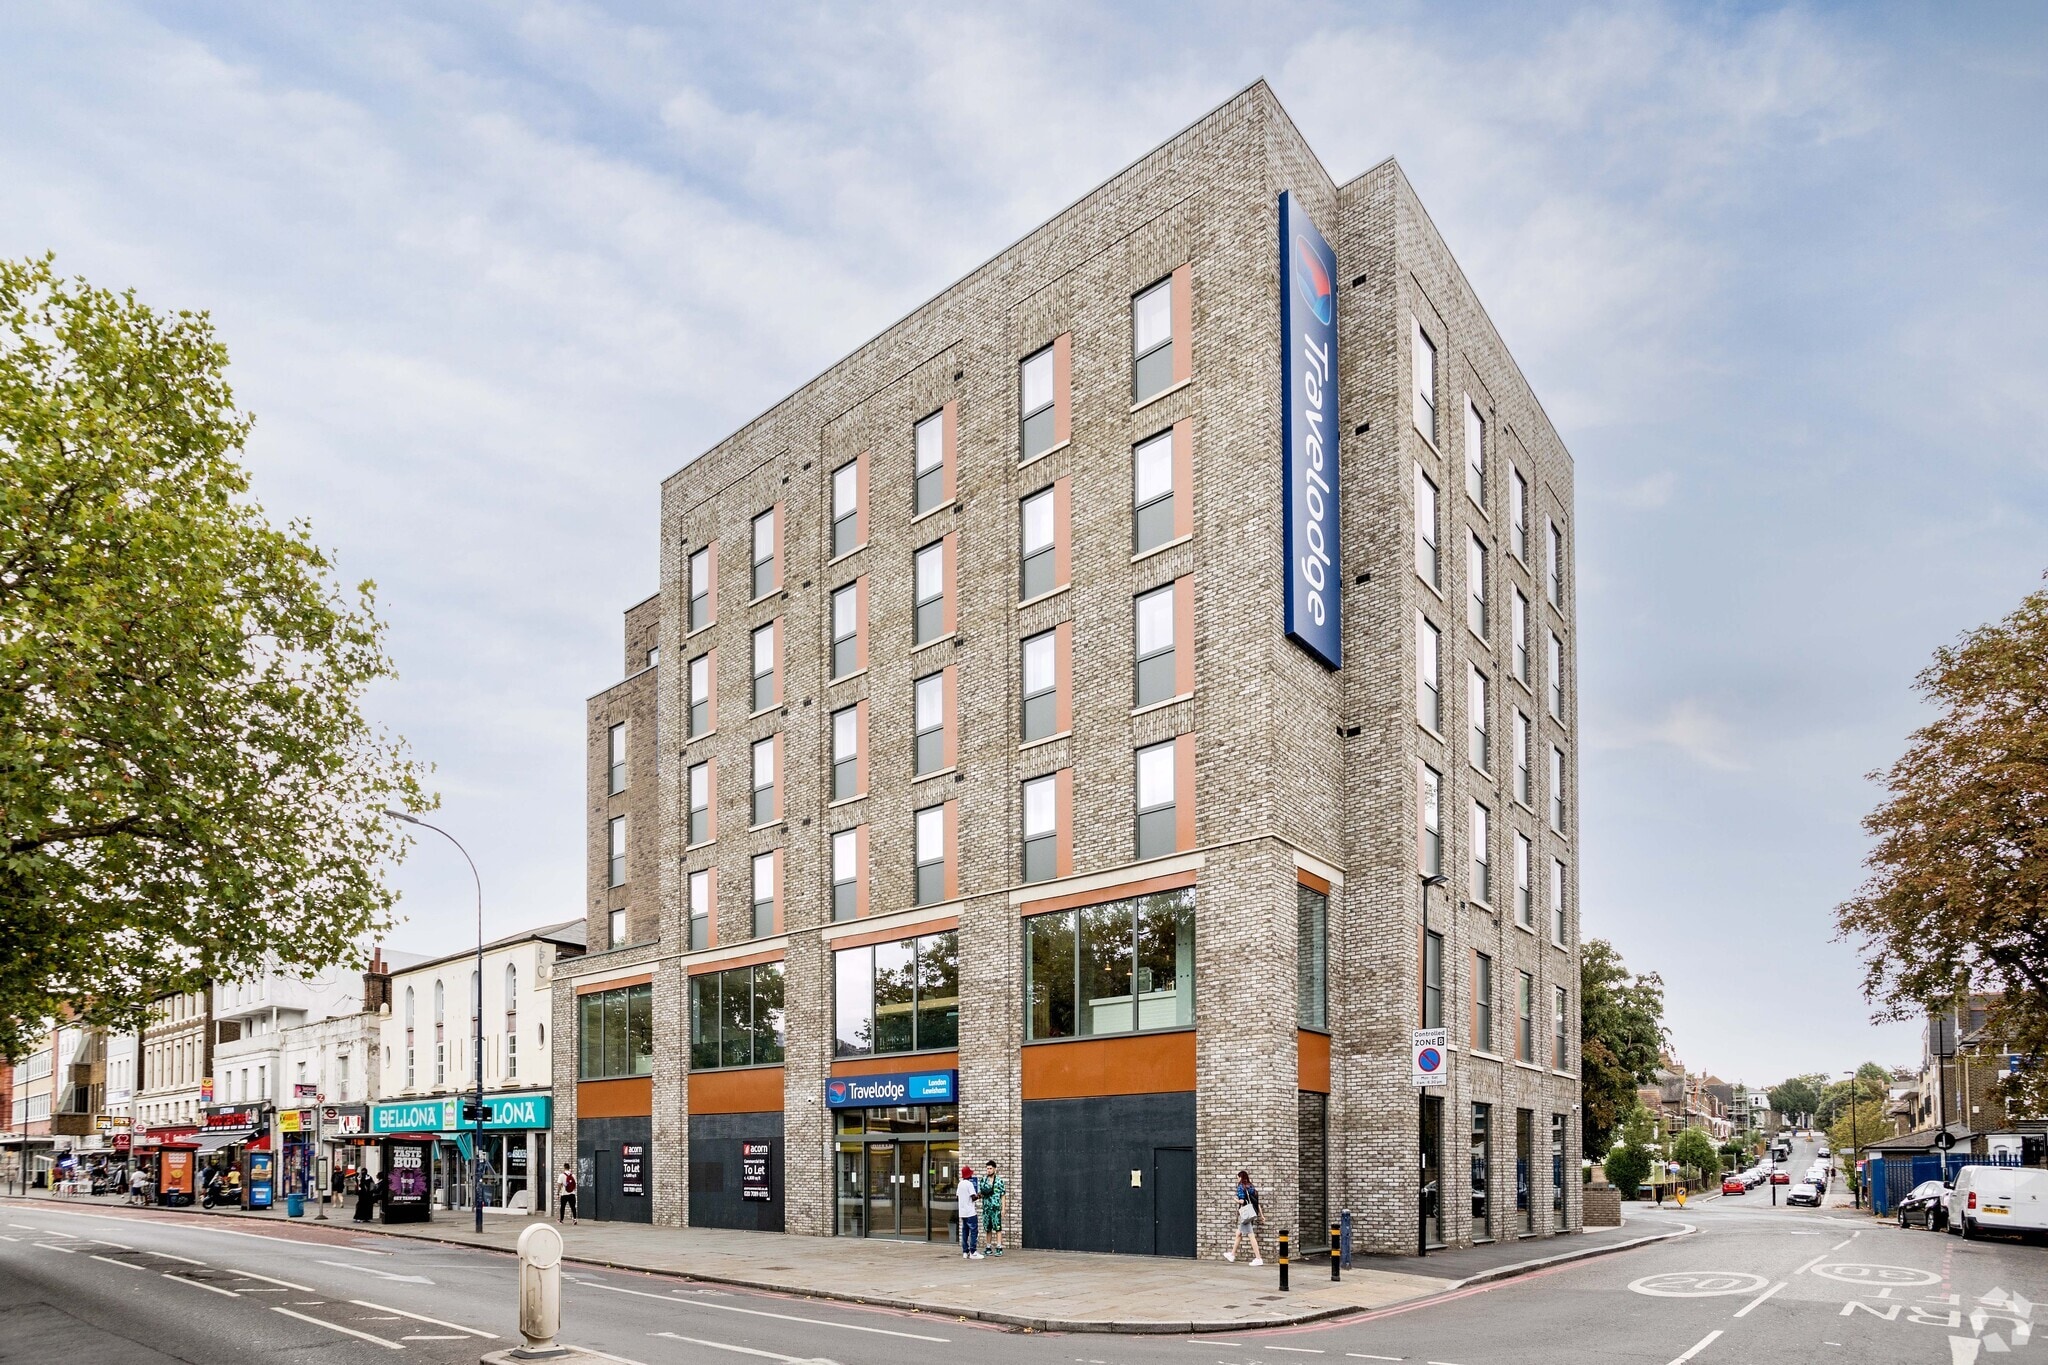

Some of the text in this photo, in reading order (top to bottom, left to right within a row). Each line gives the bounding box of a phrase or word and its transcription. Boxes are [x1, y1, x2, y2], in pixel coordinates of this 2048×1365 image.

[1301, 333, 1331, 626] Travelodge
[928, 1079, 947, 1087] London
[848, 1081, 905, 1101] Travelodge
[922, 1087, 947, 1095] Lewisham
[379, 1106, 437, 1128] BELLONA
[751, 1145, 768, 1153] acorn
[394, 1158, 421, 1168] BUD
[623, 1164, 640, 1173] To Let
[744, 1165, 765, 1174] To Let
[1832, 1265, 1916, 1281] 30
[1647, 1277, 1743, 1291] 20
